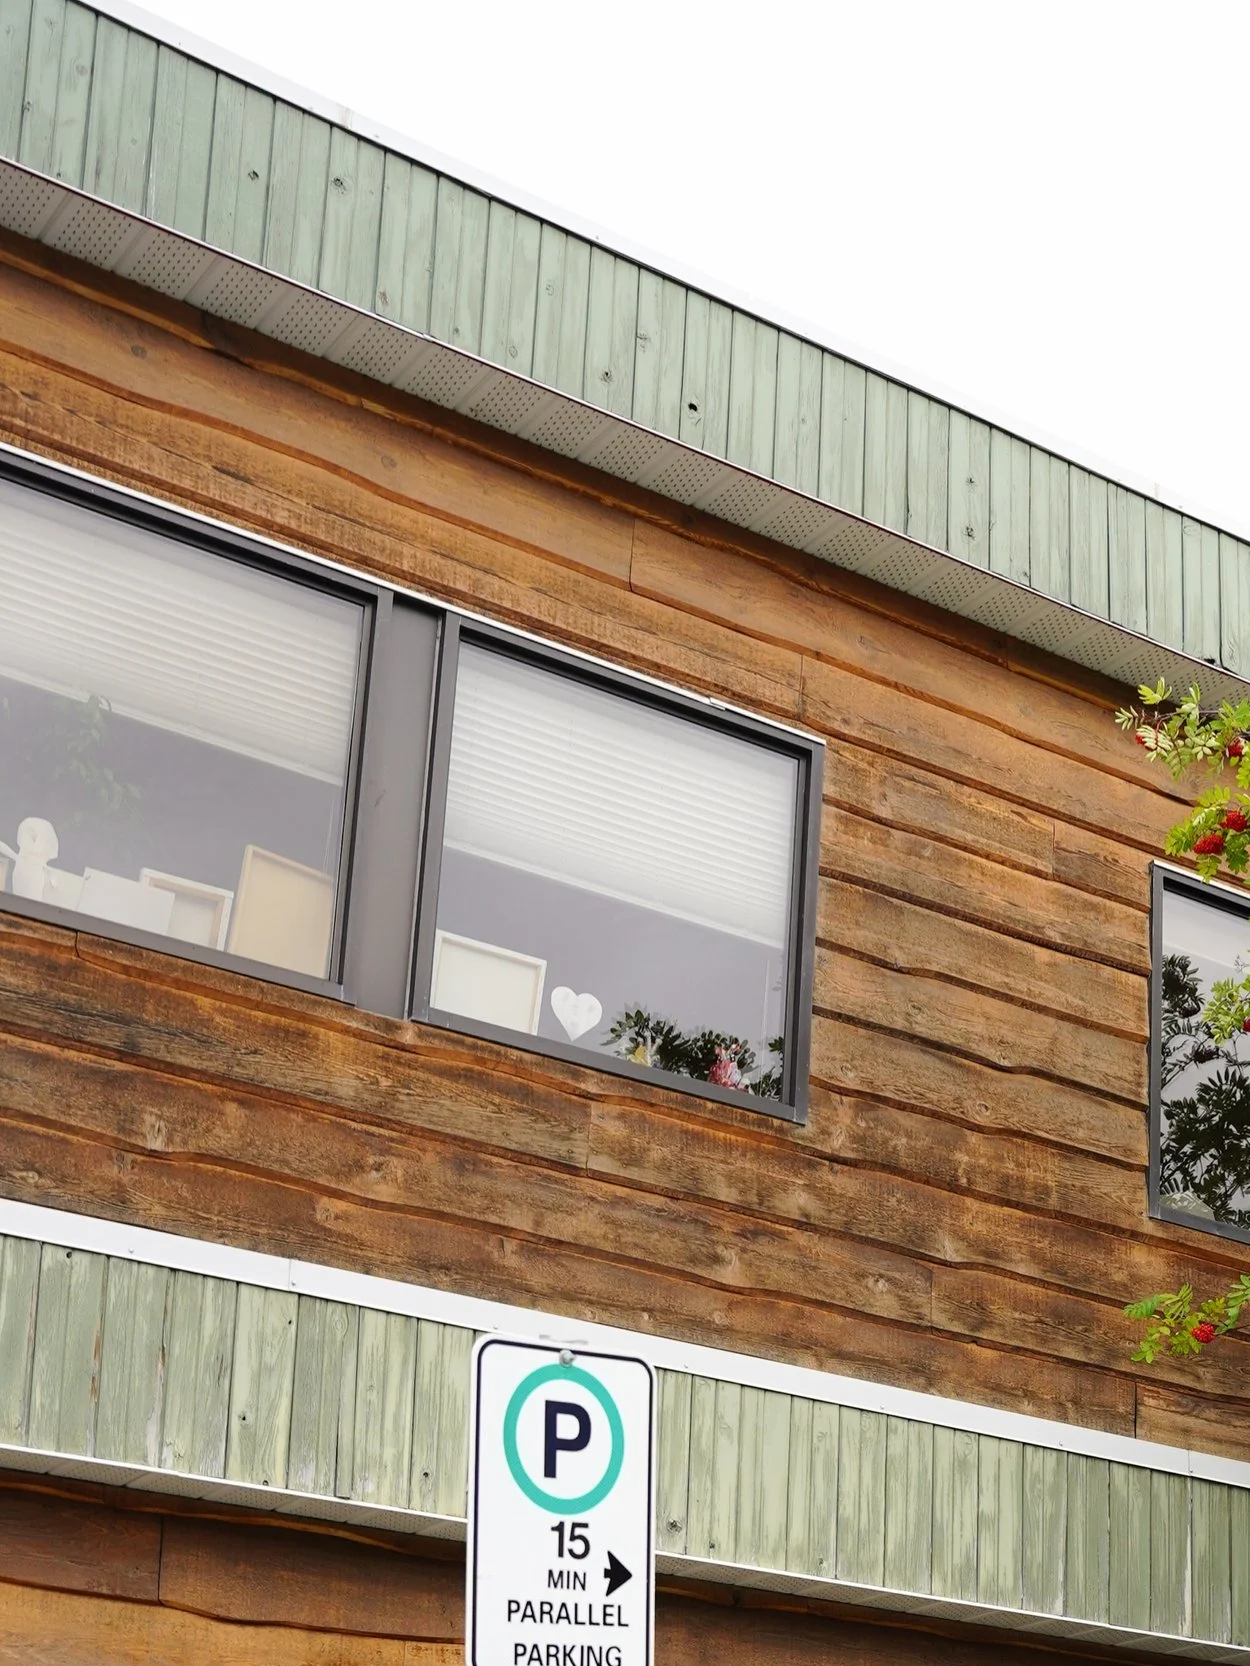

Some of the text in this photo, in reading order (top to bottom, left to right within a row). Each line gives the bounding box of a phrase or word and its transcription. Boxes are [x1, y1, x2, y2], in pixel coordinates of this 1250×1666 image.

[544, 1400, 591, 1478] P
[551, 1521, 590, 1560] 15
[547, 1569, 586, 1591] MIN
[507, 1600, 629, 1627] PARALLEL
